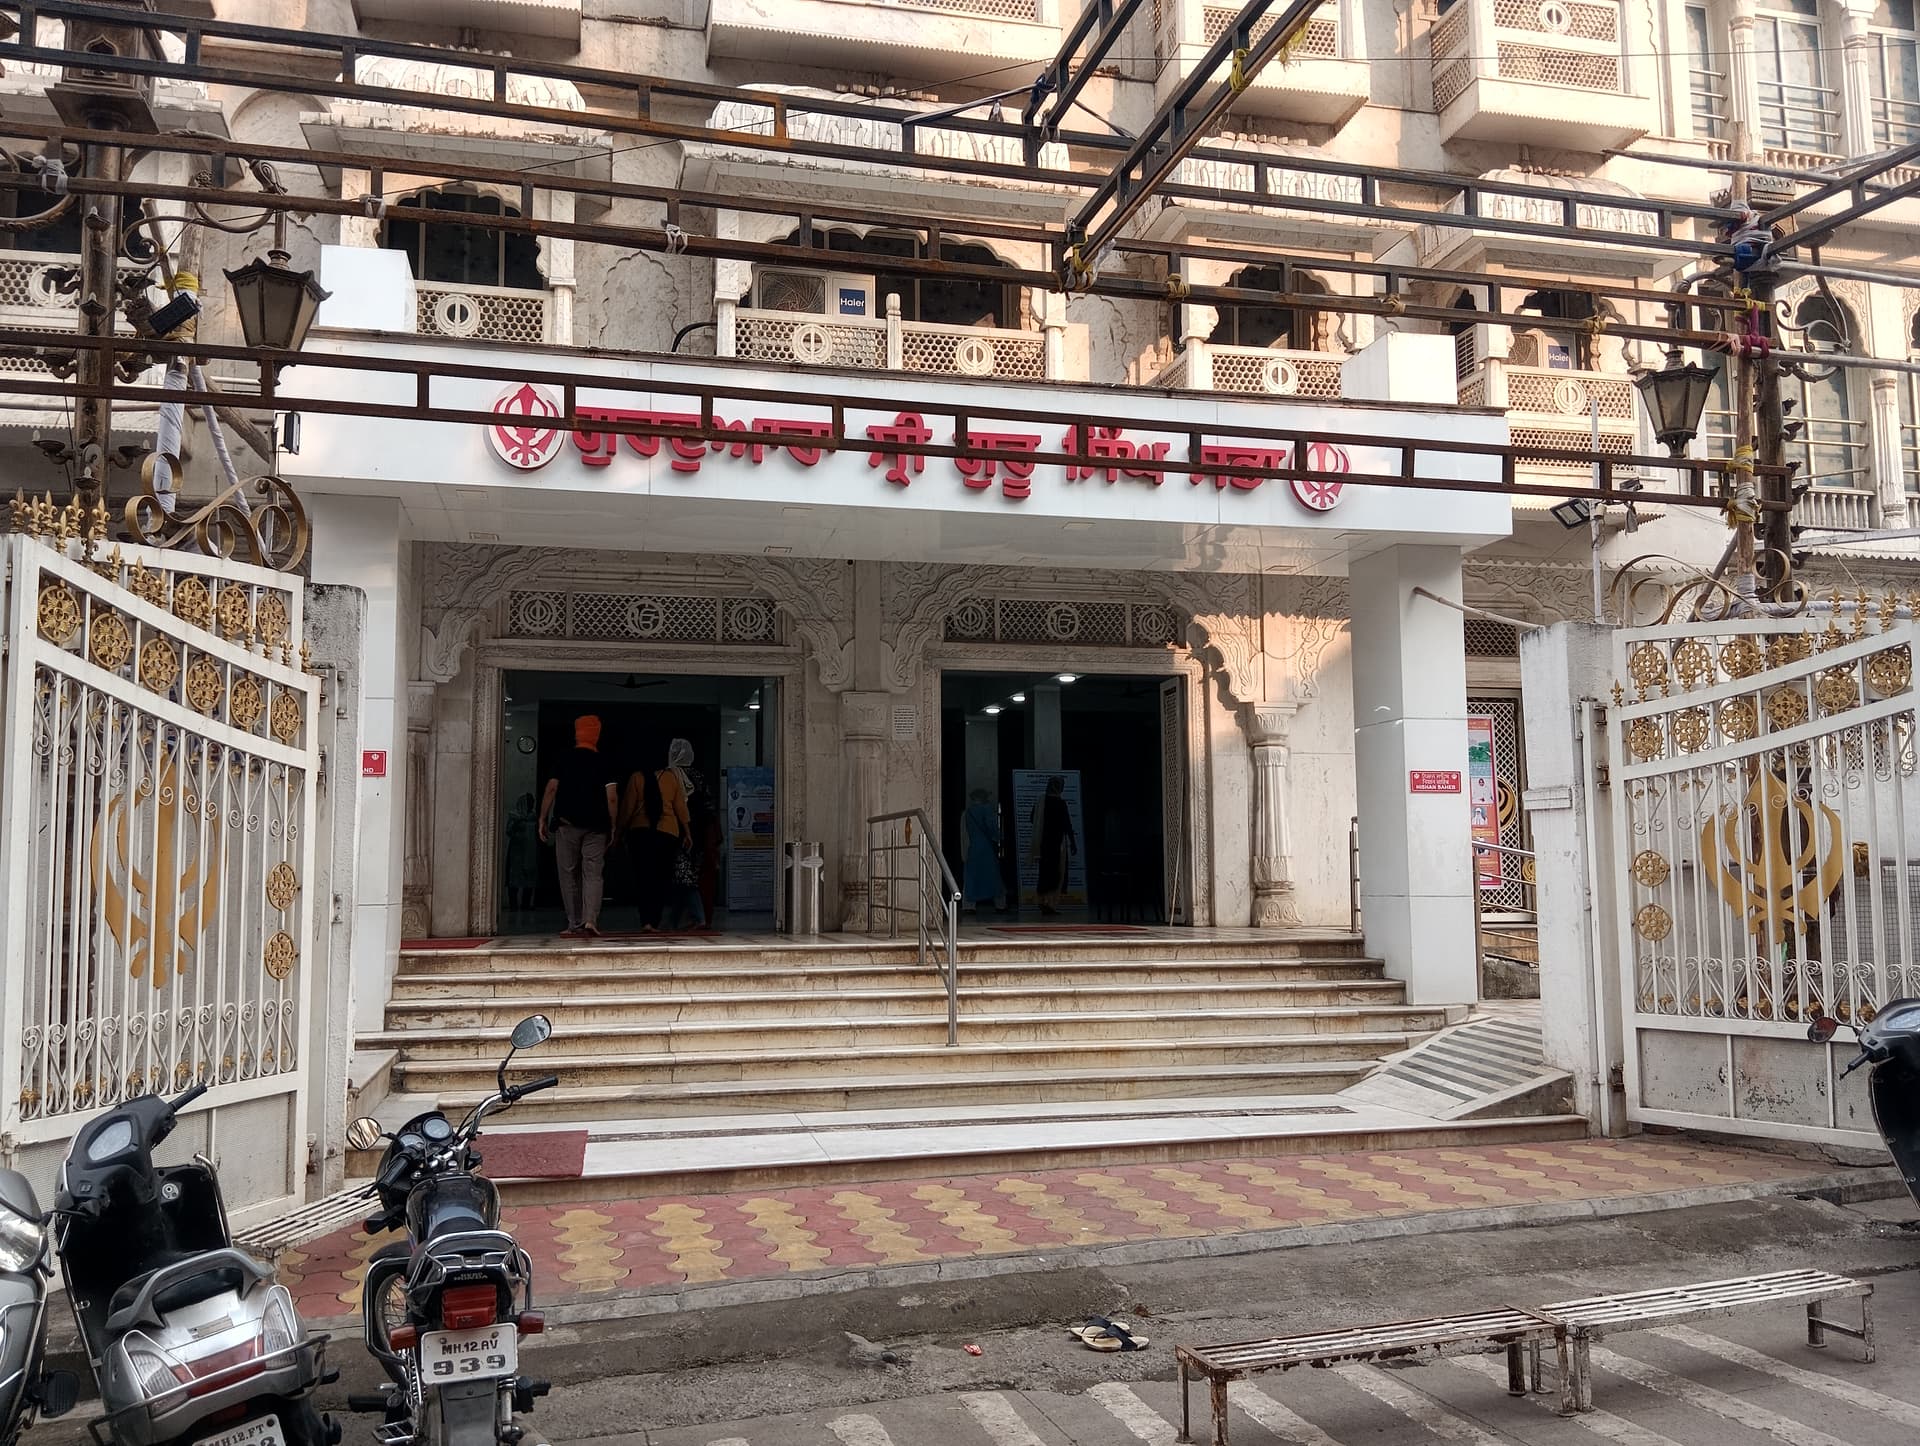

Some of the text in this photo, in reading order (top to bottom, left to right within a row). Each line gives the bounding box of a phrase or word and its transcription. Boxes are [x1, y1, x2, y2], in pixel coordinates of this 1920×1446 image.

[840, 297, 865, 307] Haier
[1549, 353, 1569, 361] Haier
[433, 1355, 506, 1376] 939
